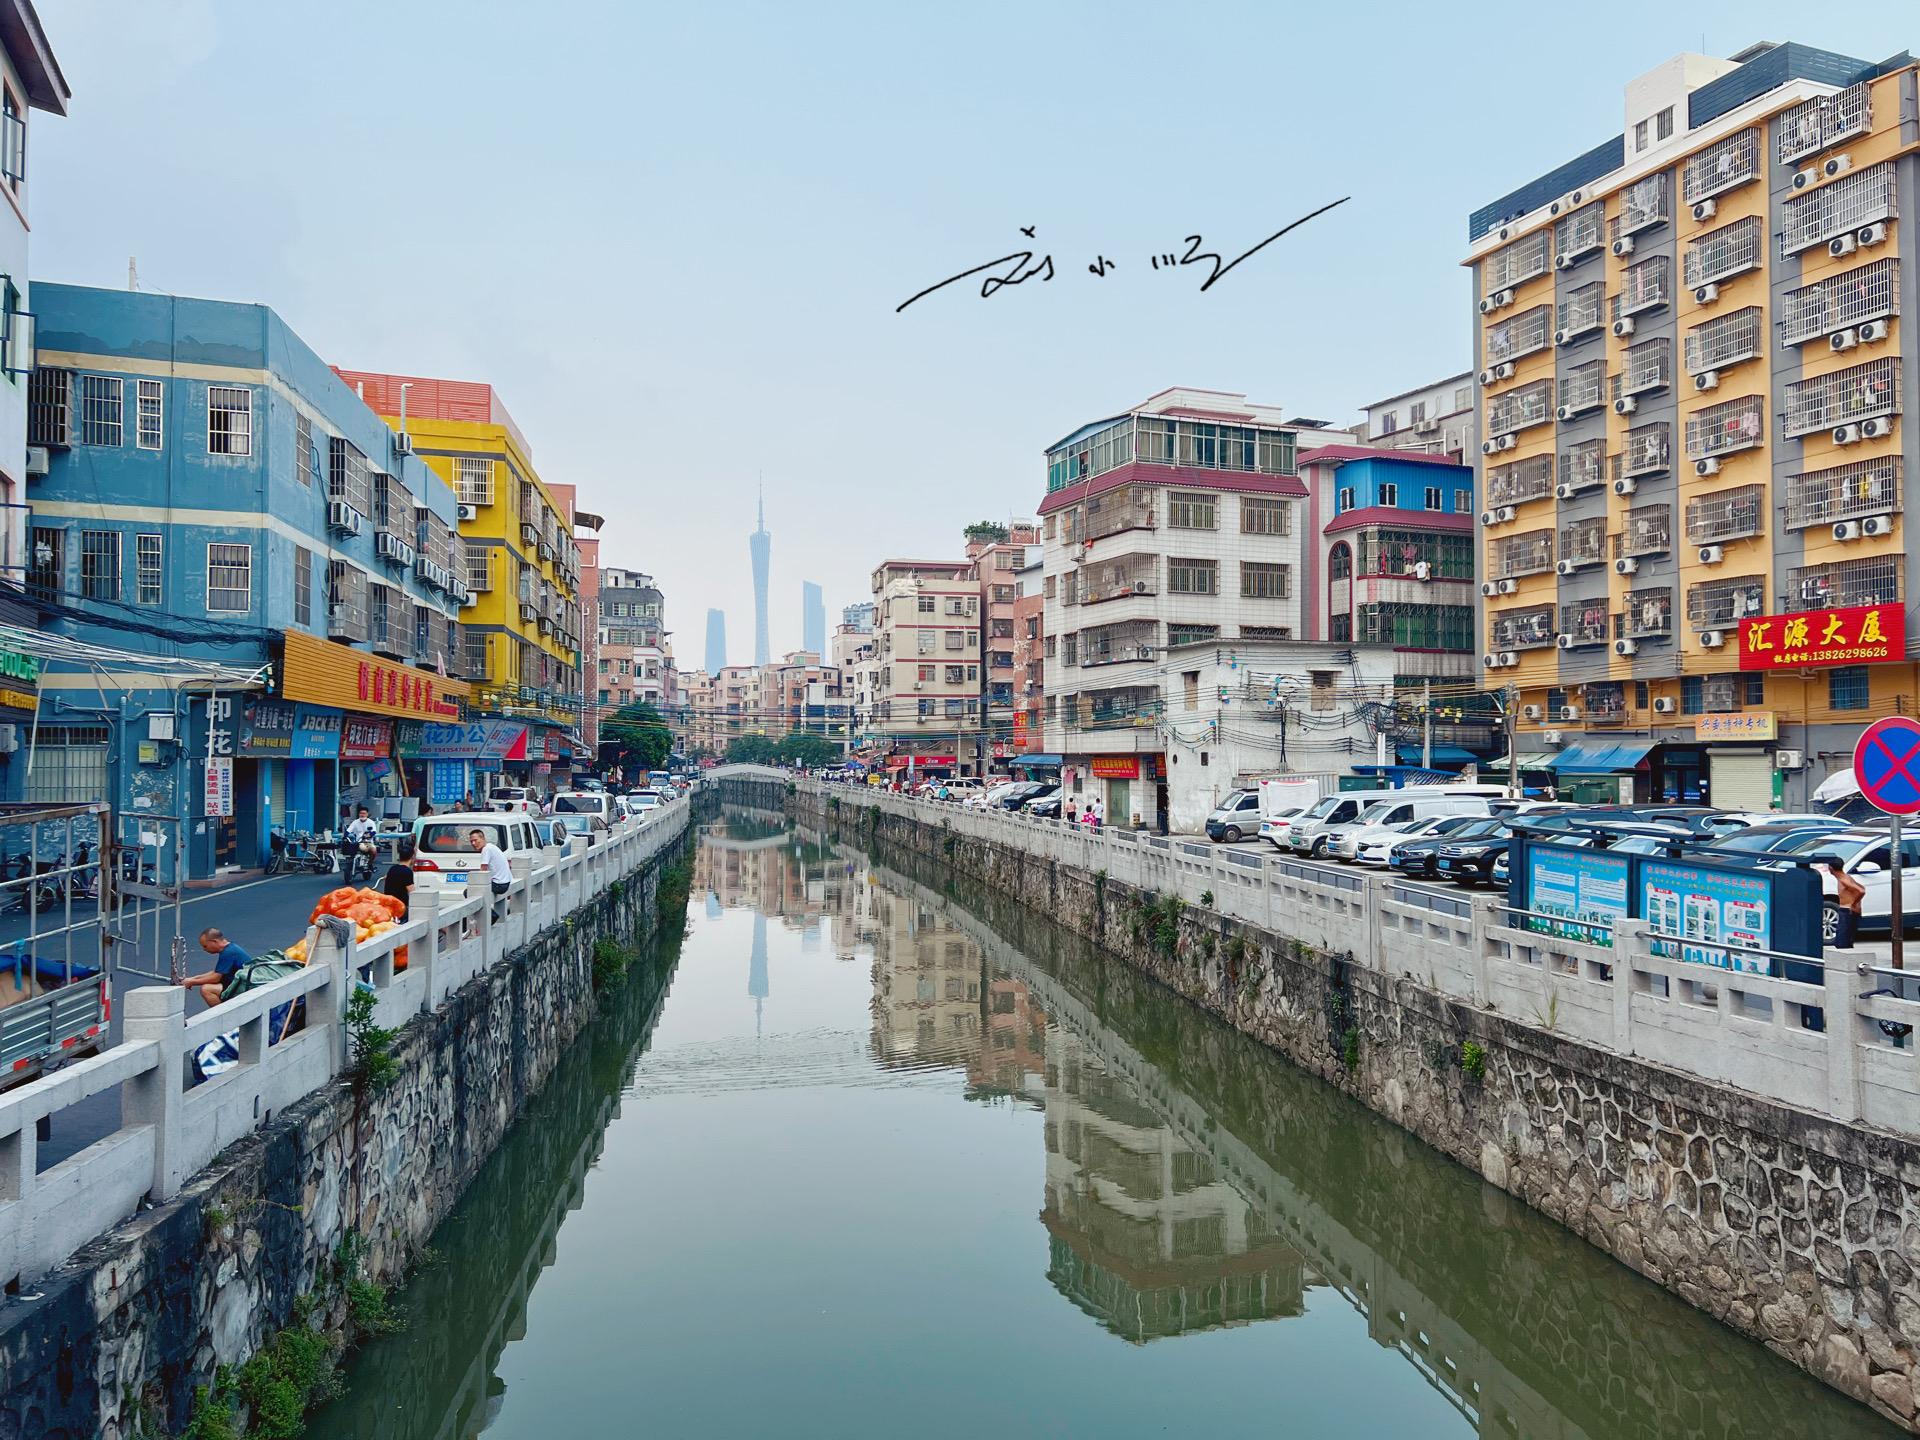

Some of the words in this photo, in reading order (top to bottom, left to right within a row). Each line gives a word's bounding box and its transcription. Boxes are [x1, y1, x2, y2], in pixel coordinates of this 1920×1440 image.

[1748, 610, 1887, 652] 汇源大厦
[205, 697, 232, 754] 印花
